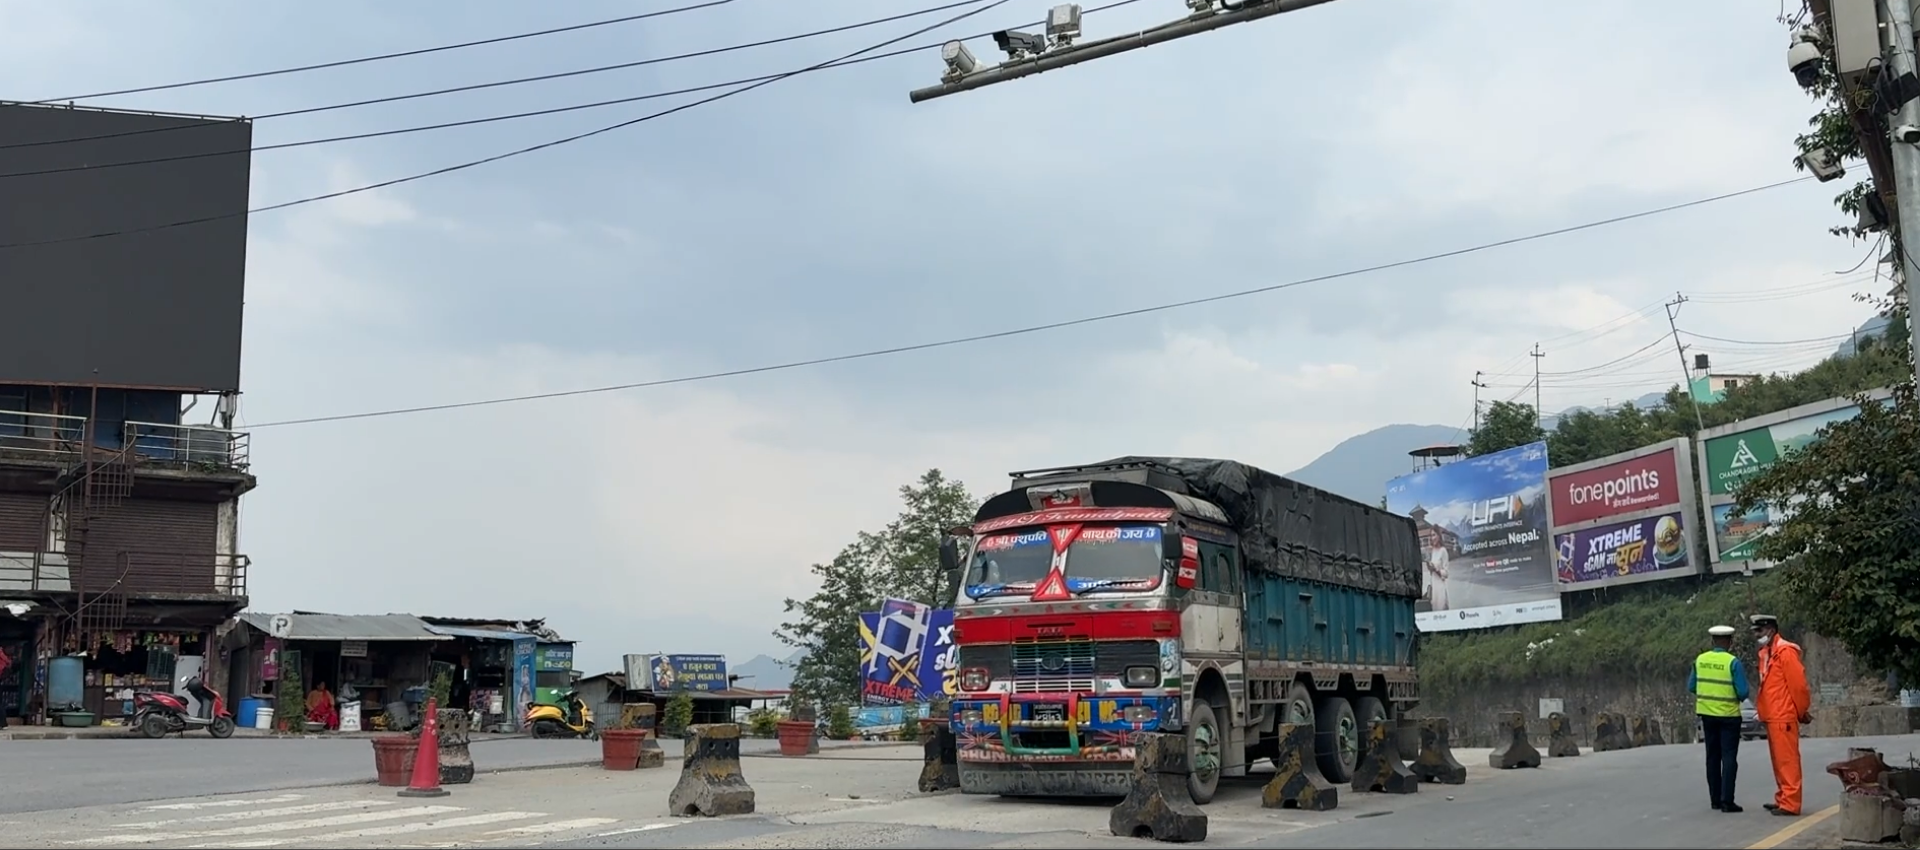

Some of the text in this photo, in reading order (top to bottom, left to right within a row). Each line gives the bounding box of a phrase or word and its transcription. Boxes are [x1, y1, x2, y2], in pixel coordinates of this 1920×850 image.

[1569, 469, 1659, 506] fonepoints
[1471, 495, 1514, 526] UPI
[1105, 527, 1121, 539] की
[1122, 529, 1144, 539] जय
[1463, 528, 1540, 551] Accepted across Nepal.
[1588, 523, 1642, 555] XTREME
[1583, 551, 1606, 572] sCAN
[1615, 540, 1647, 576] सुन
[276, 618, 289, 634] P
[1037, 626, 1065, 634] TATA
[864, 680, 915, 702] XTREME
